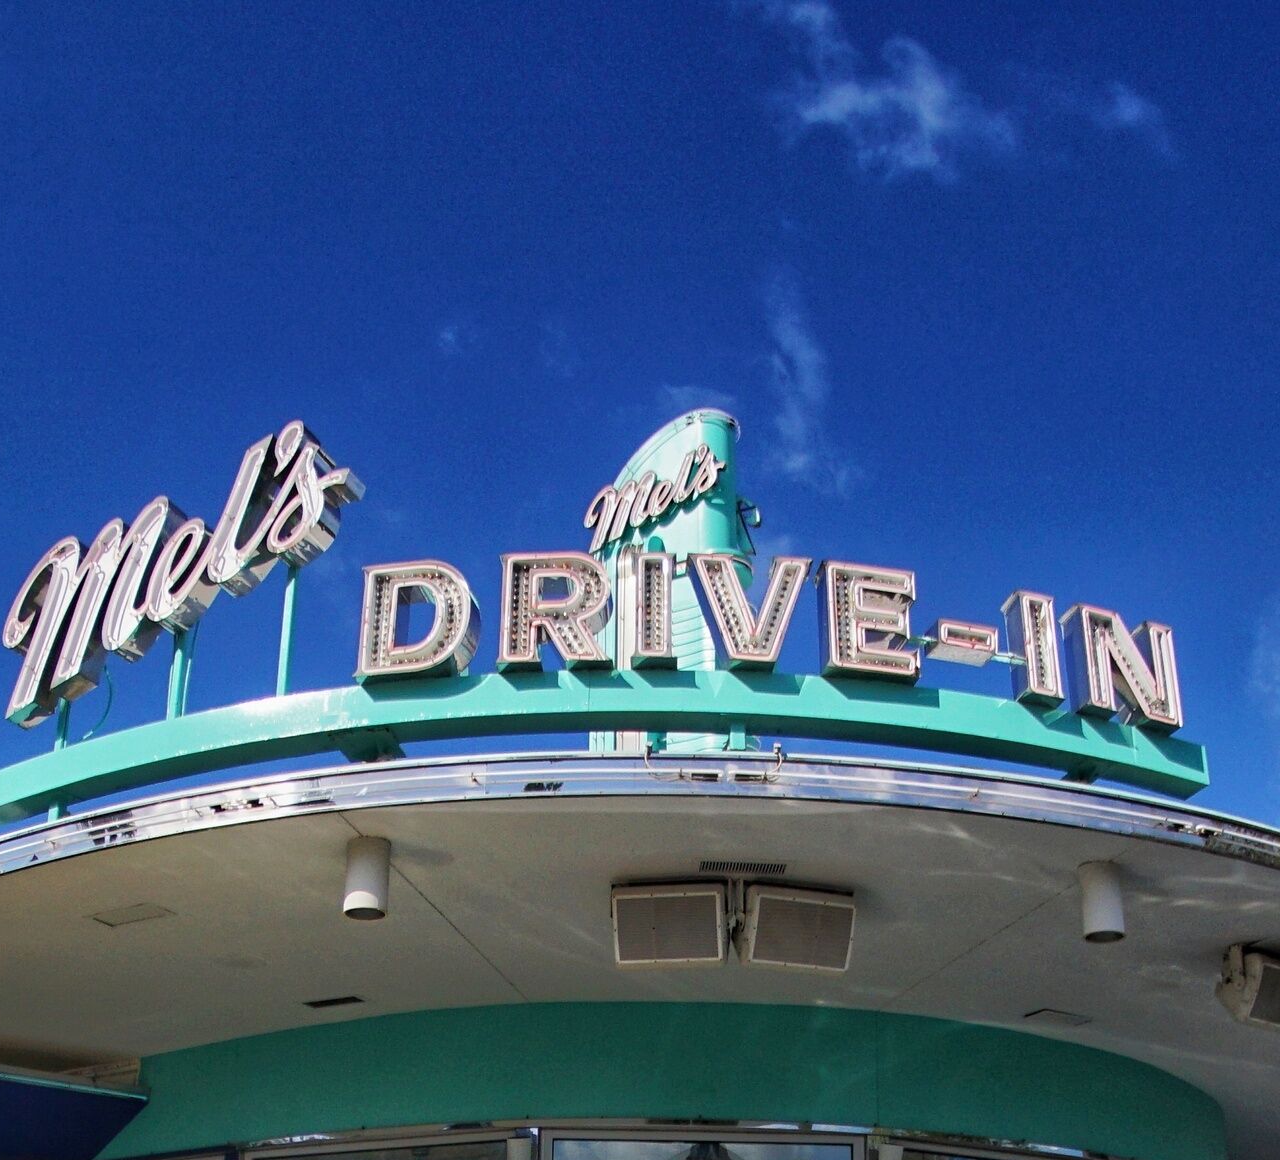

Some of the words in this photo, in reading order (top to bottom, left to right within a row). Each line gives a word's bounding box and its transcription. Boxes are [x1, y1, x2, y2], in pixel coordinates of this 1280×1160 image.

[2, 419, 360, 728] Mel's
[583, 443, 726, 553] Mel's
[353, 551, 1184, 736] DRIVE-IN
